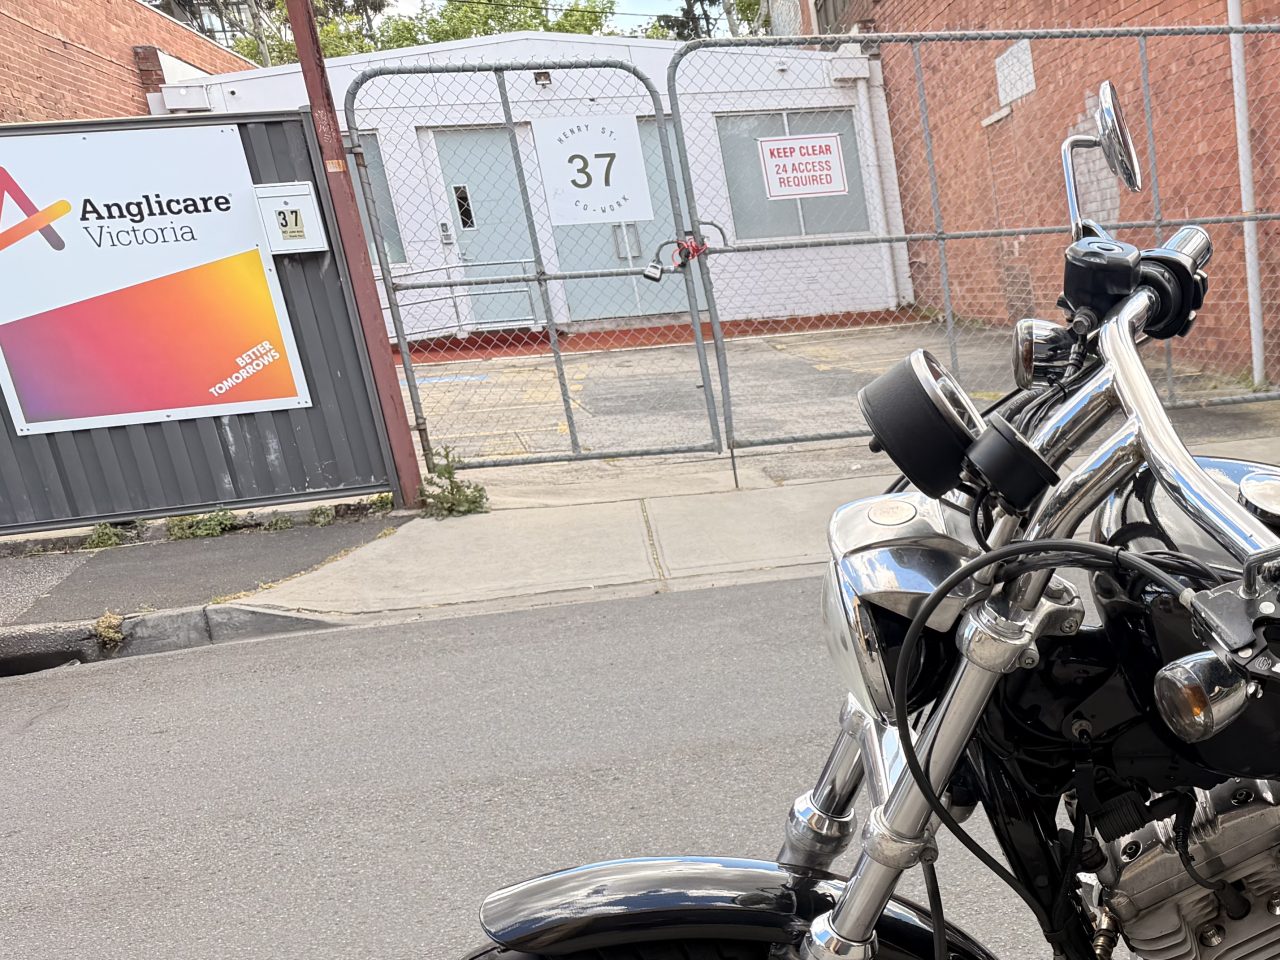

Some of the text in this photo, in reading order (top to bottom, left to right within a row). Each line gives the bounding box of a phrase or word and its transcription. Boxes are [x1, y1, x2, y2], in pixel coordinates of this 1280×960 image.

[557, 124, 616, 144] HENRY ST.
[769, 144, 832, 159] KEEP CLEAR
[567, 152, 616, 189] 37
[774, 160, 832, 175] 24 ACCESS
[778, 173, 833, 188] REQUIRED
[80, 193, 231, 224] Anglicare
[574, 194, 629, 214] CO-WORK
[277, 210, 299, 228] 37
[83, 221, 198, 248] Victoria
[235, 340, 273, 368] BETTER
[209, 349, 280, 397] TOMORROWS
